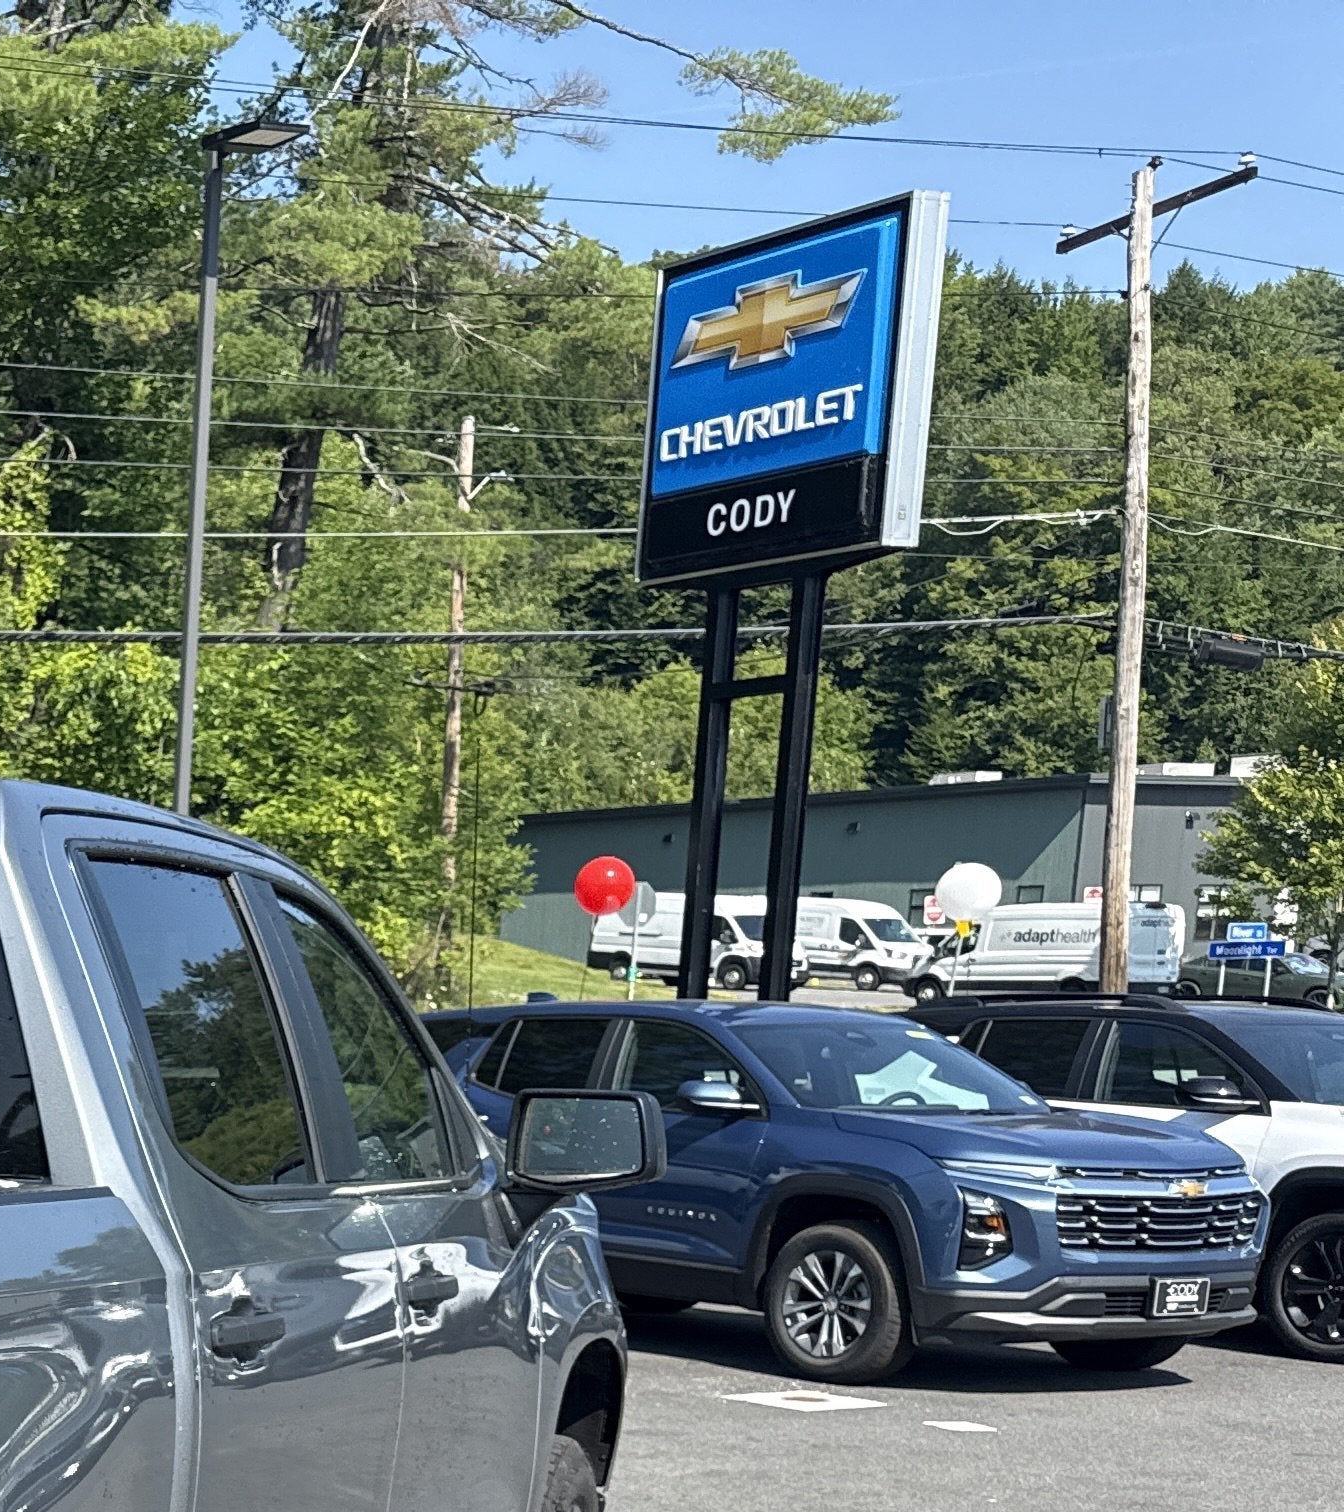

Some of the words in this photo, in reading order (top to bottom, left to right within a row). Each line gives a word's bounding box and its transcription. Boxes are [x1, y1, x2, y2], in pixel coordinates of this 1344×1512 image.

[659, 383, 864, 462] CHEVROLET
[706, 488, 797, 537] CODY
[1013, 928, 1096, 945] adapthealth
